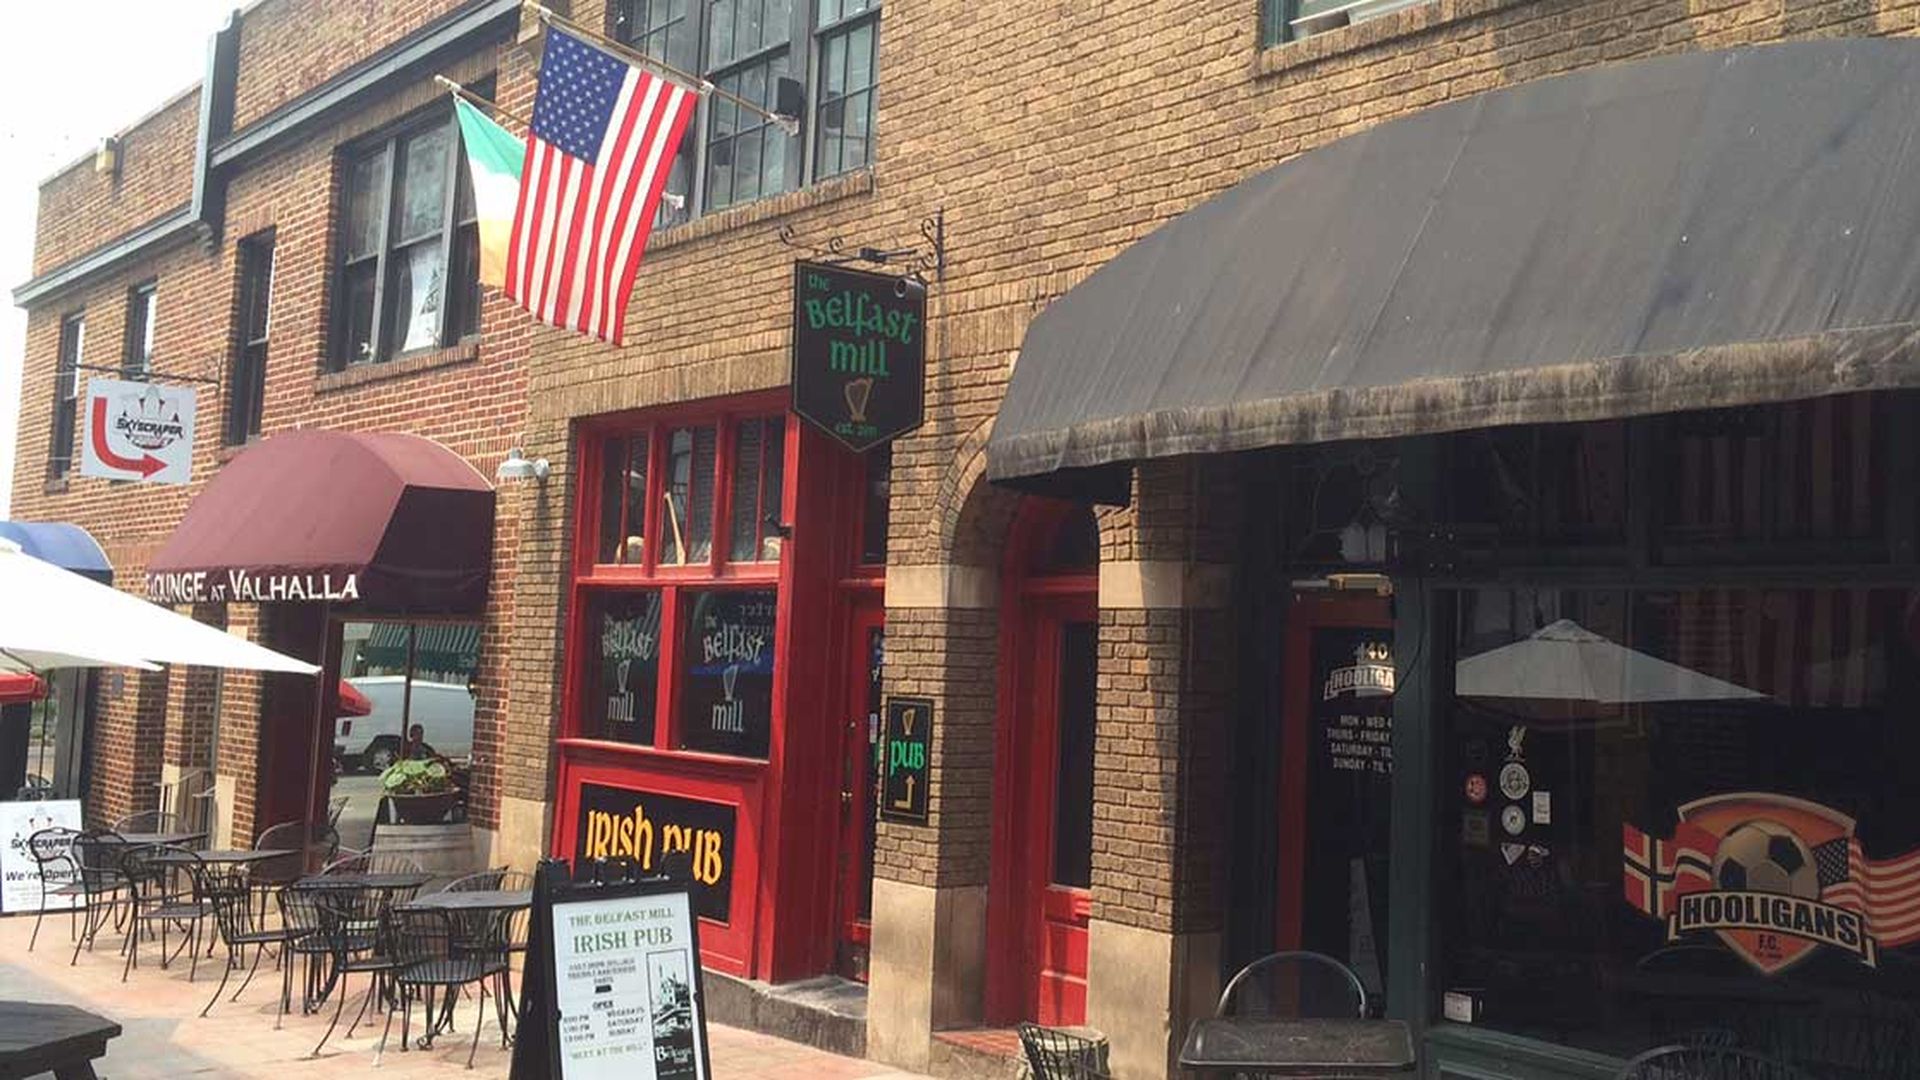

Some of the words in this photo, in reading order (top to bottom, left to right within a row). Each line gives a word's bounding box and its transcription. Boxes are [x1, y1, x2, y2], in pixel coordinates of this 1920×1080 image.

[115, 418, 184, 439] SKYSCRAPER
[150, 571, 207, 603] LOUNGE
[210, 584, 226, 601] AT
[229, 569, 359, 600] VALHALLA
[1366, 716, 1385, 728] WED
[1360, 730, 1390, 743] FRIDAY
[1331, 742, 1373, 756] SATURDAY
[1333, 758, 1365, 770] SUNDAY
[570, 915, 592, 926] THE
[596, 910, 646, 924] BELFAST
[648, 907, 674, 919] MILL
[1683, 895, 1858, 947] HOOLIGANS
[574, 930, 626, 953] IRISH
[635, 926, 673, 947] PUB
